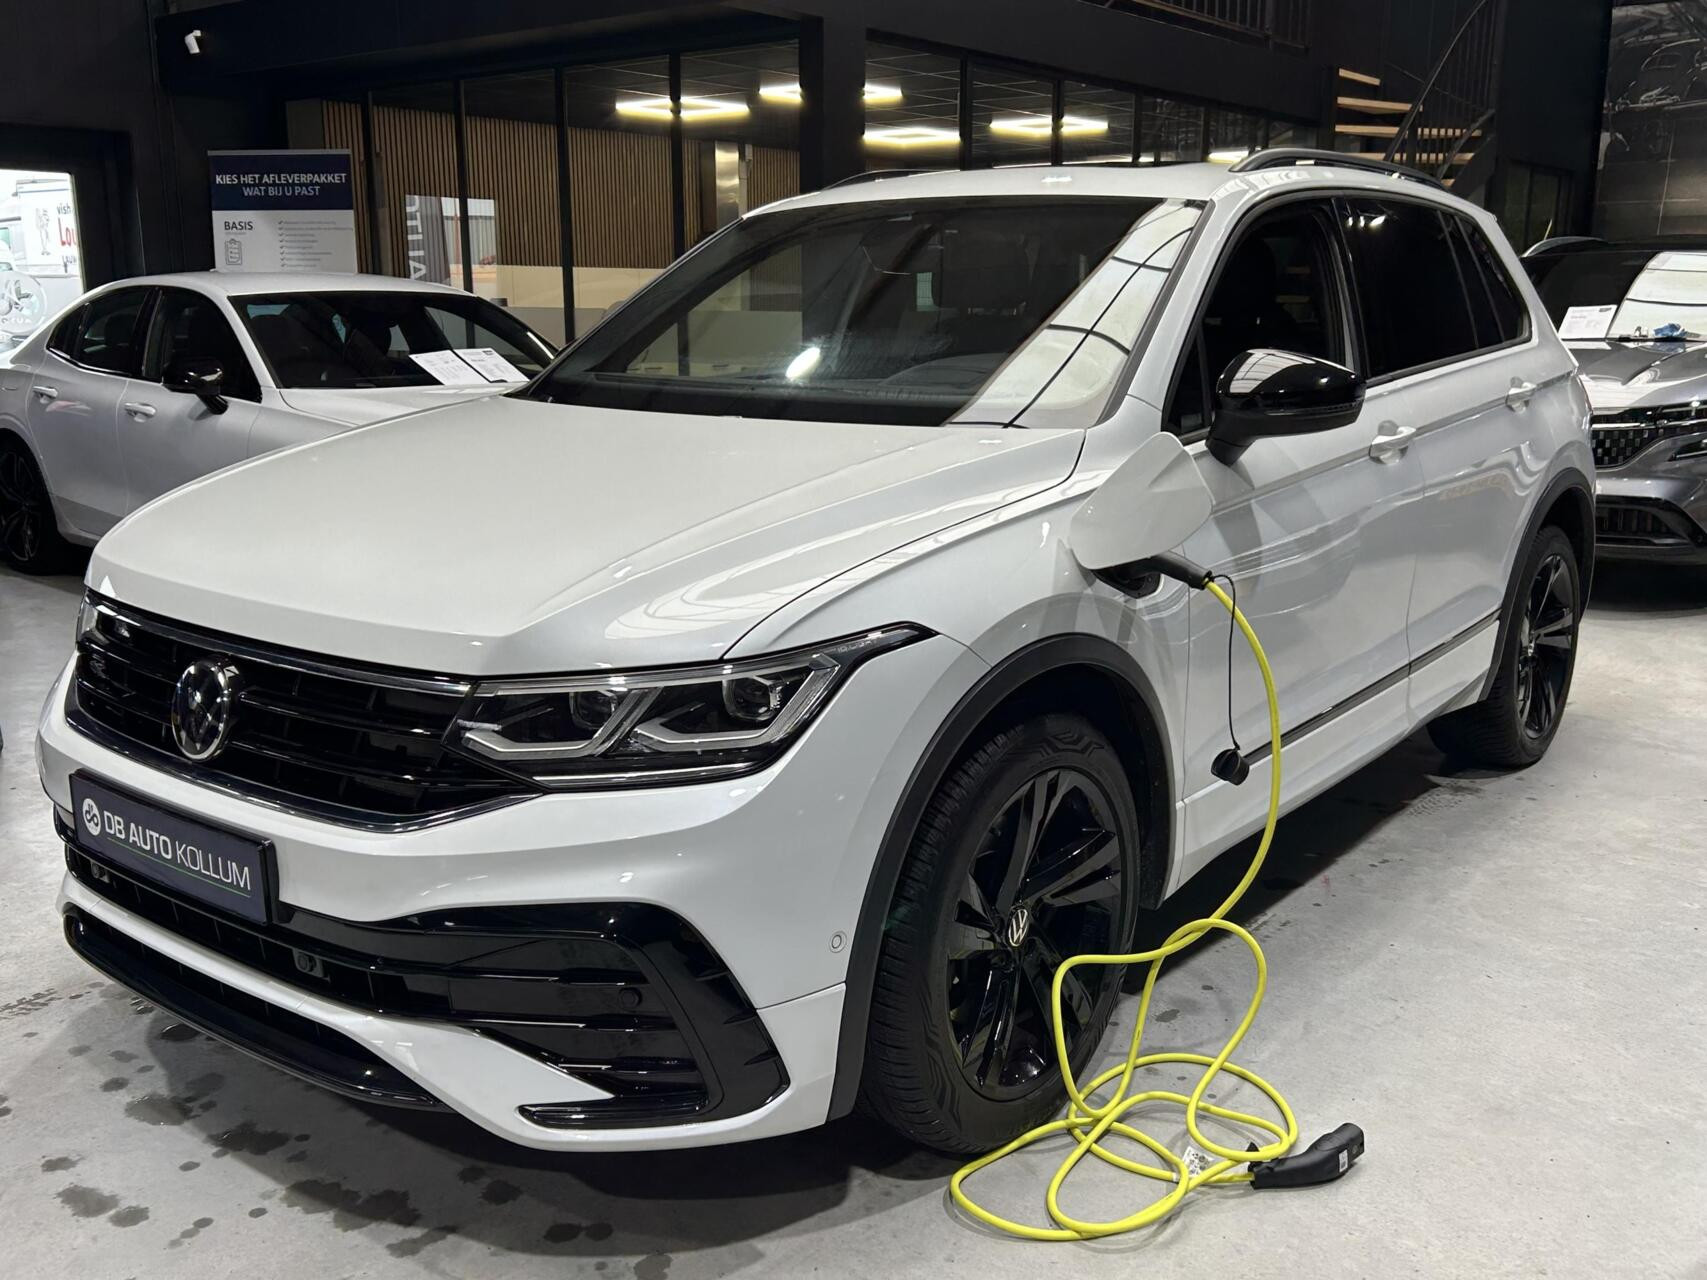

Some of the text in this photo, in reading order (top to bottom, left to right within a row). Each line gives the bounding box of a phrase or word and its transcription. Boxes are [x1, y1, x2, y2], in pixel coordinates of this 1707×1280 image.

[215, 173, 347, 185] KIES HET AFLEVERPAKKET
[242, 186, 320, 196] WAT BIJ U PAST
[224, 220, 253, 231] BASIS
[104, 810, 251, 891] DB AUTO KOLLUM
